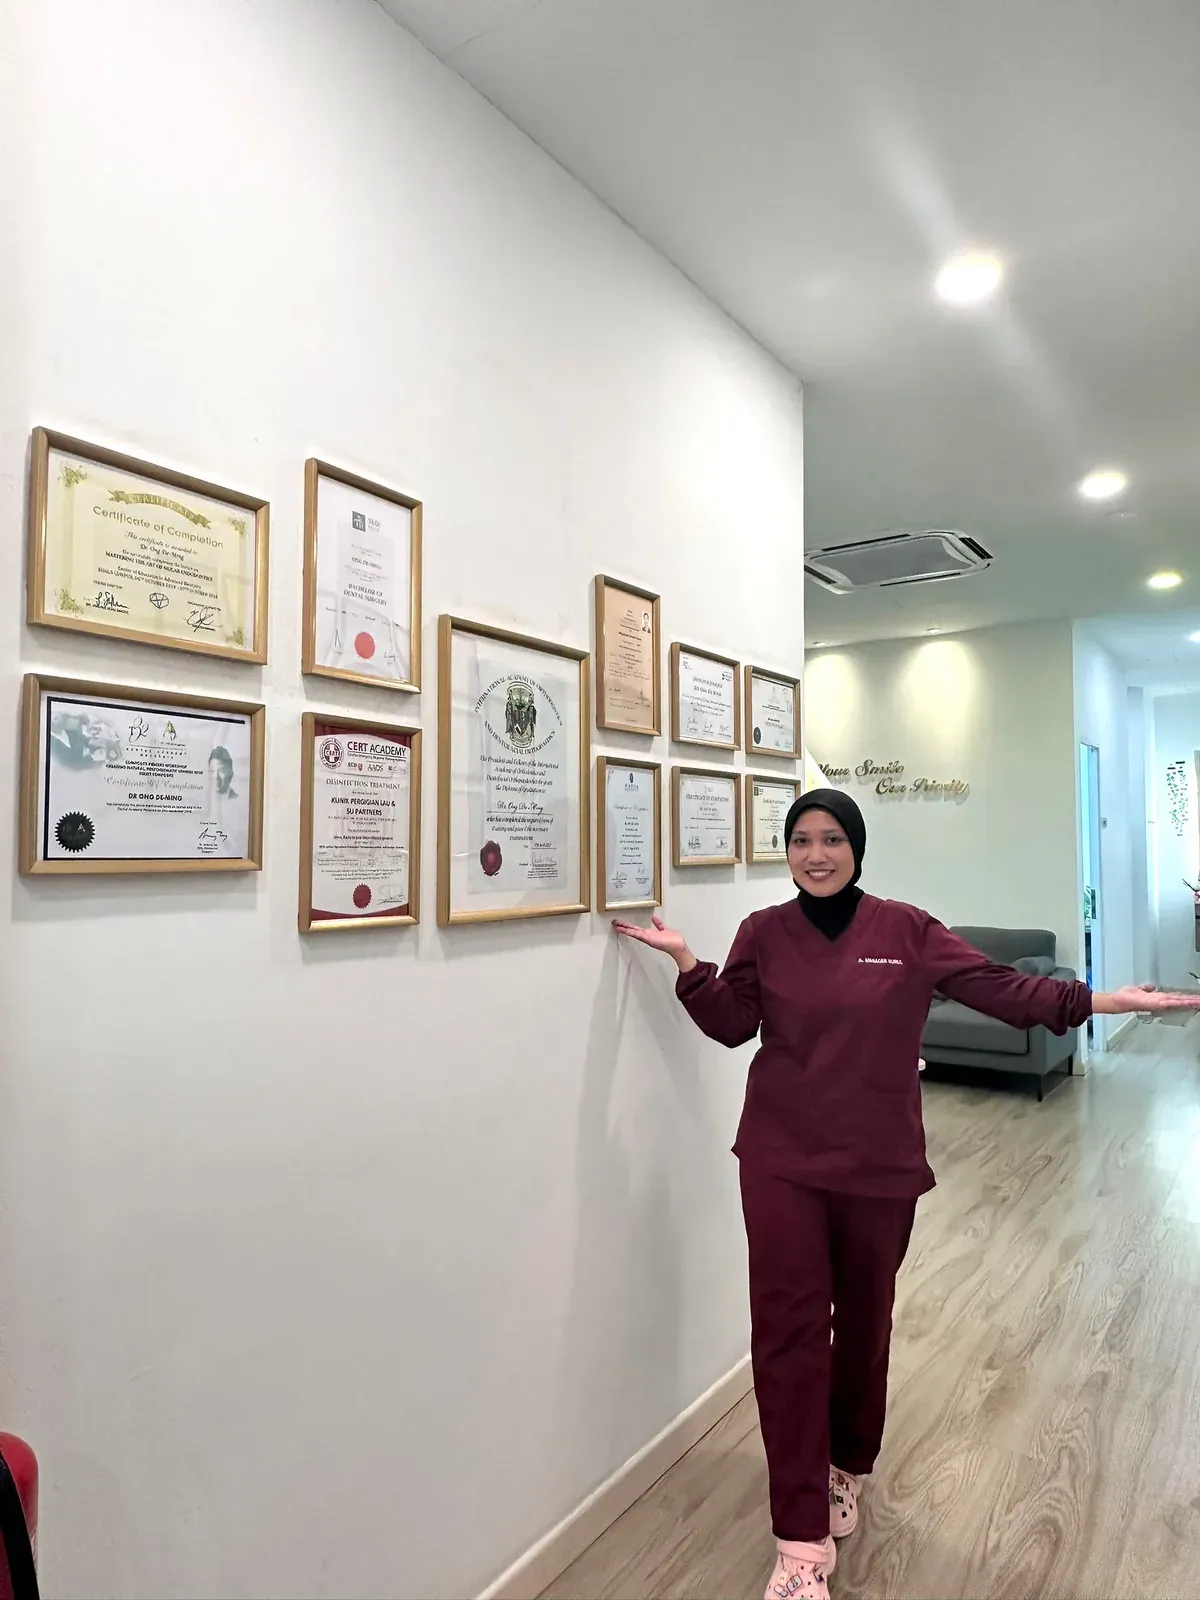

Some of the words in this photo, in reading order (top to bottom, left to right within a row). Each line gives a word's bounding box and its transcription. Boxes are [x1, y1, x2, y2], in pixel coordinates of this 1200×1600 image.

[93, 506, 150, 528] Certificate
[153, 525, 164, 534] of
[167, 526, 223, 548] Completion
[348, 583, 376, 595] BACHELOR
[343, 589, 364, 600] DENTAL
[364, 595, 387, 606] SURGERY
[347, 741, 368, 752] CERT
[369, 744, 407, 756] ACADEMY
[855, 759, 904, 777] Smile
[326, 778, 368, 788] DISINFECTION
[369, 781, 400, 790] TREATMENT
[875, 777, 906, 795] Our
[909, 777, 968, 796] Priority
[355, 808, 382, 816] PARTNERS
